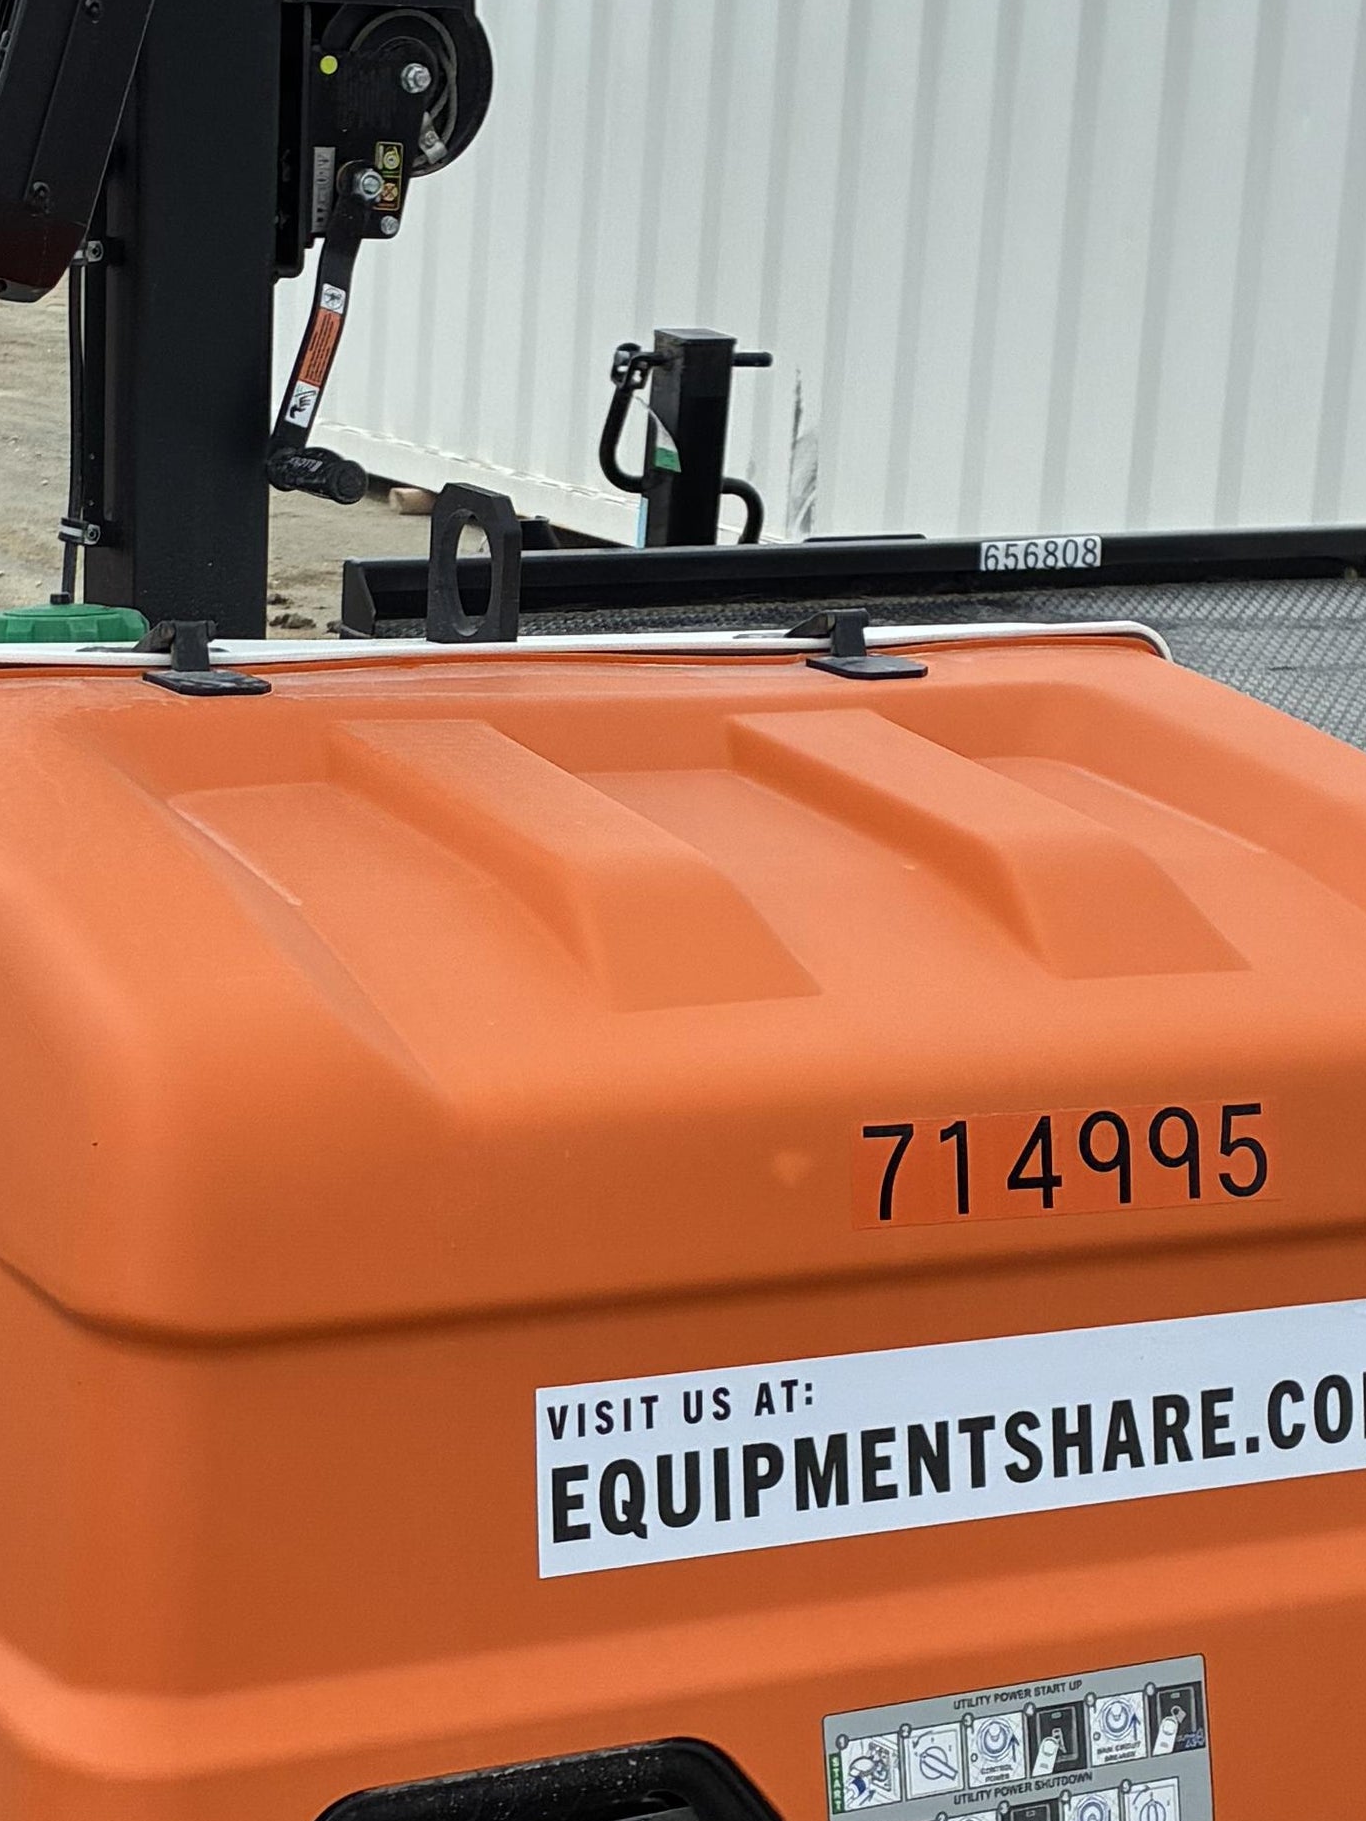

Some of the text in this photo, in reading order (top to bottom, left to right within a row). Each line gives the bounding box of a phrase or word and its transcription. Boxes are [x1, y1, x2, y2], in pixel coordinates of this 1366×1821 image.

[983, 537, 1098, 572] 656808
[861, 1102, 1269, 1222] 714995
[547, 1378, 814, 1440] VISIT US AT:
[953, 1679, 1082, 1710] UTILITY POWER START UP
[952, 1771, 1092, 1806] UTILITY POWER SHUTDOWN
